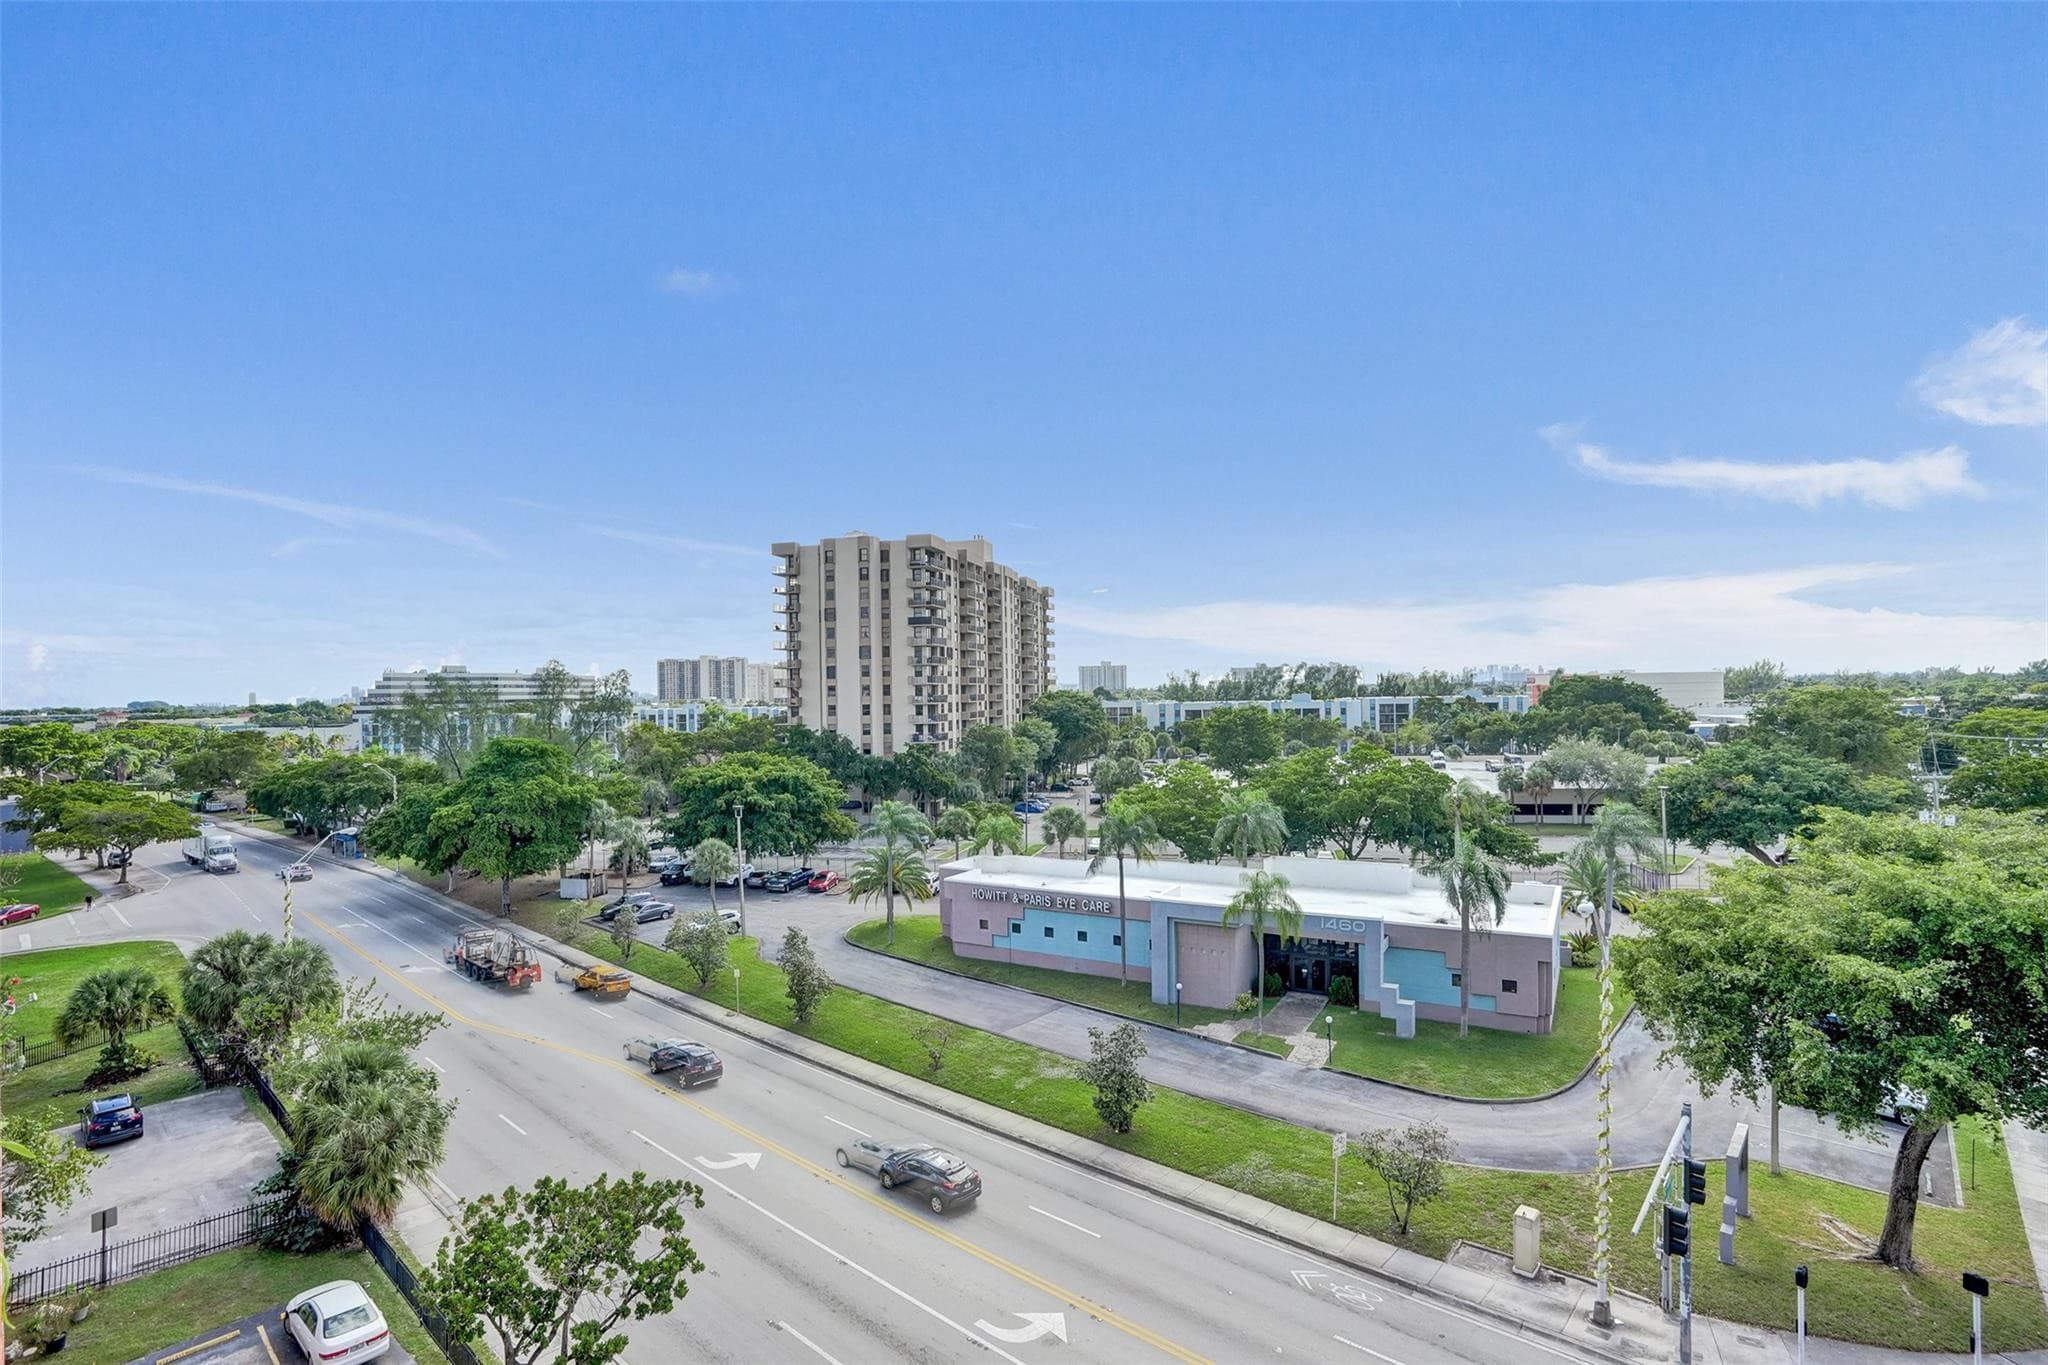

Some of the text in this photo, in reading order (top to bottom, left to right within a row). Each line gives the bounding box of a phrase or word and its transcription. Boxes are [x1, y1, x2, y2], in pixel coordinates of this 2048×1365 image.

[971, 888, 1111, 912] HOWITT & PARIS EYE CARE
[1321, 917, 1366, 932] 1460
